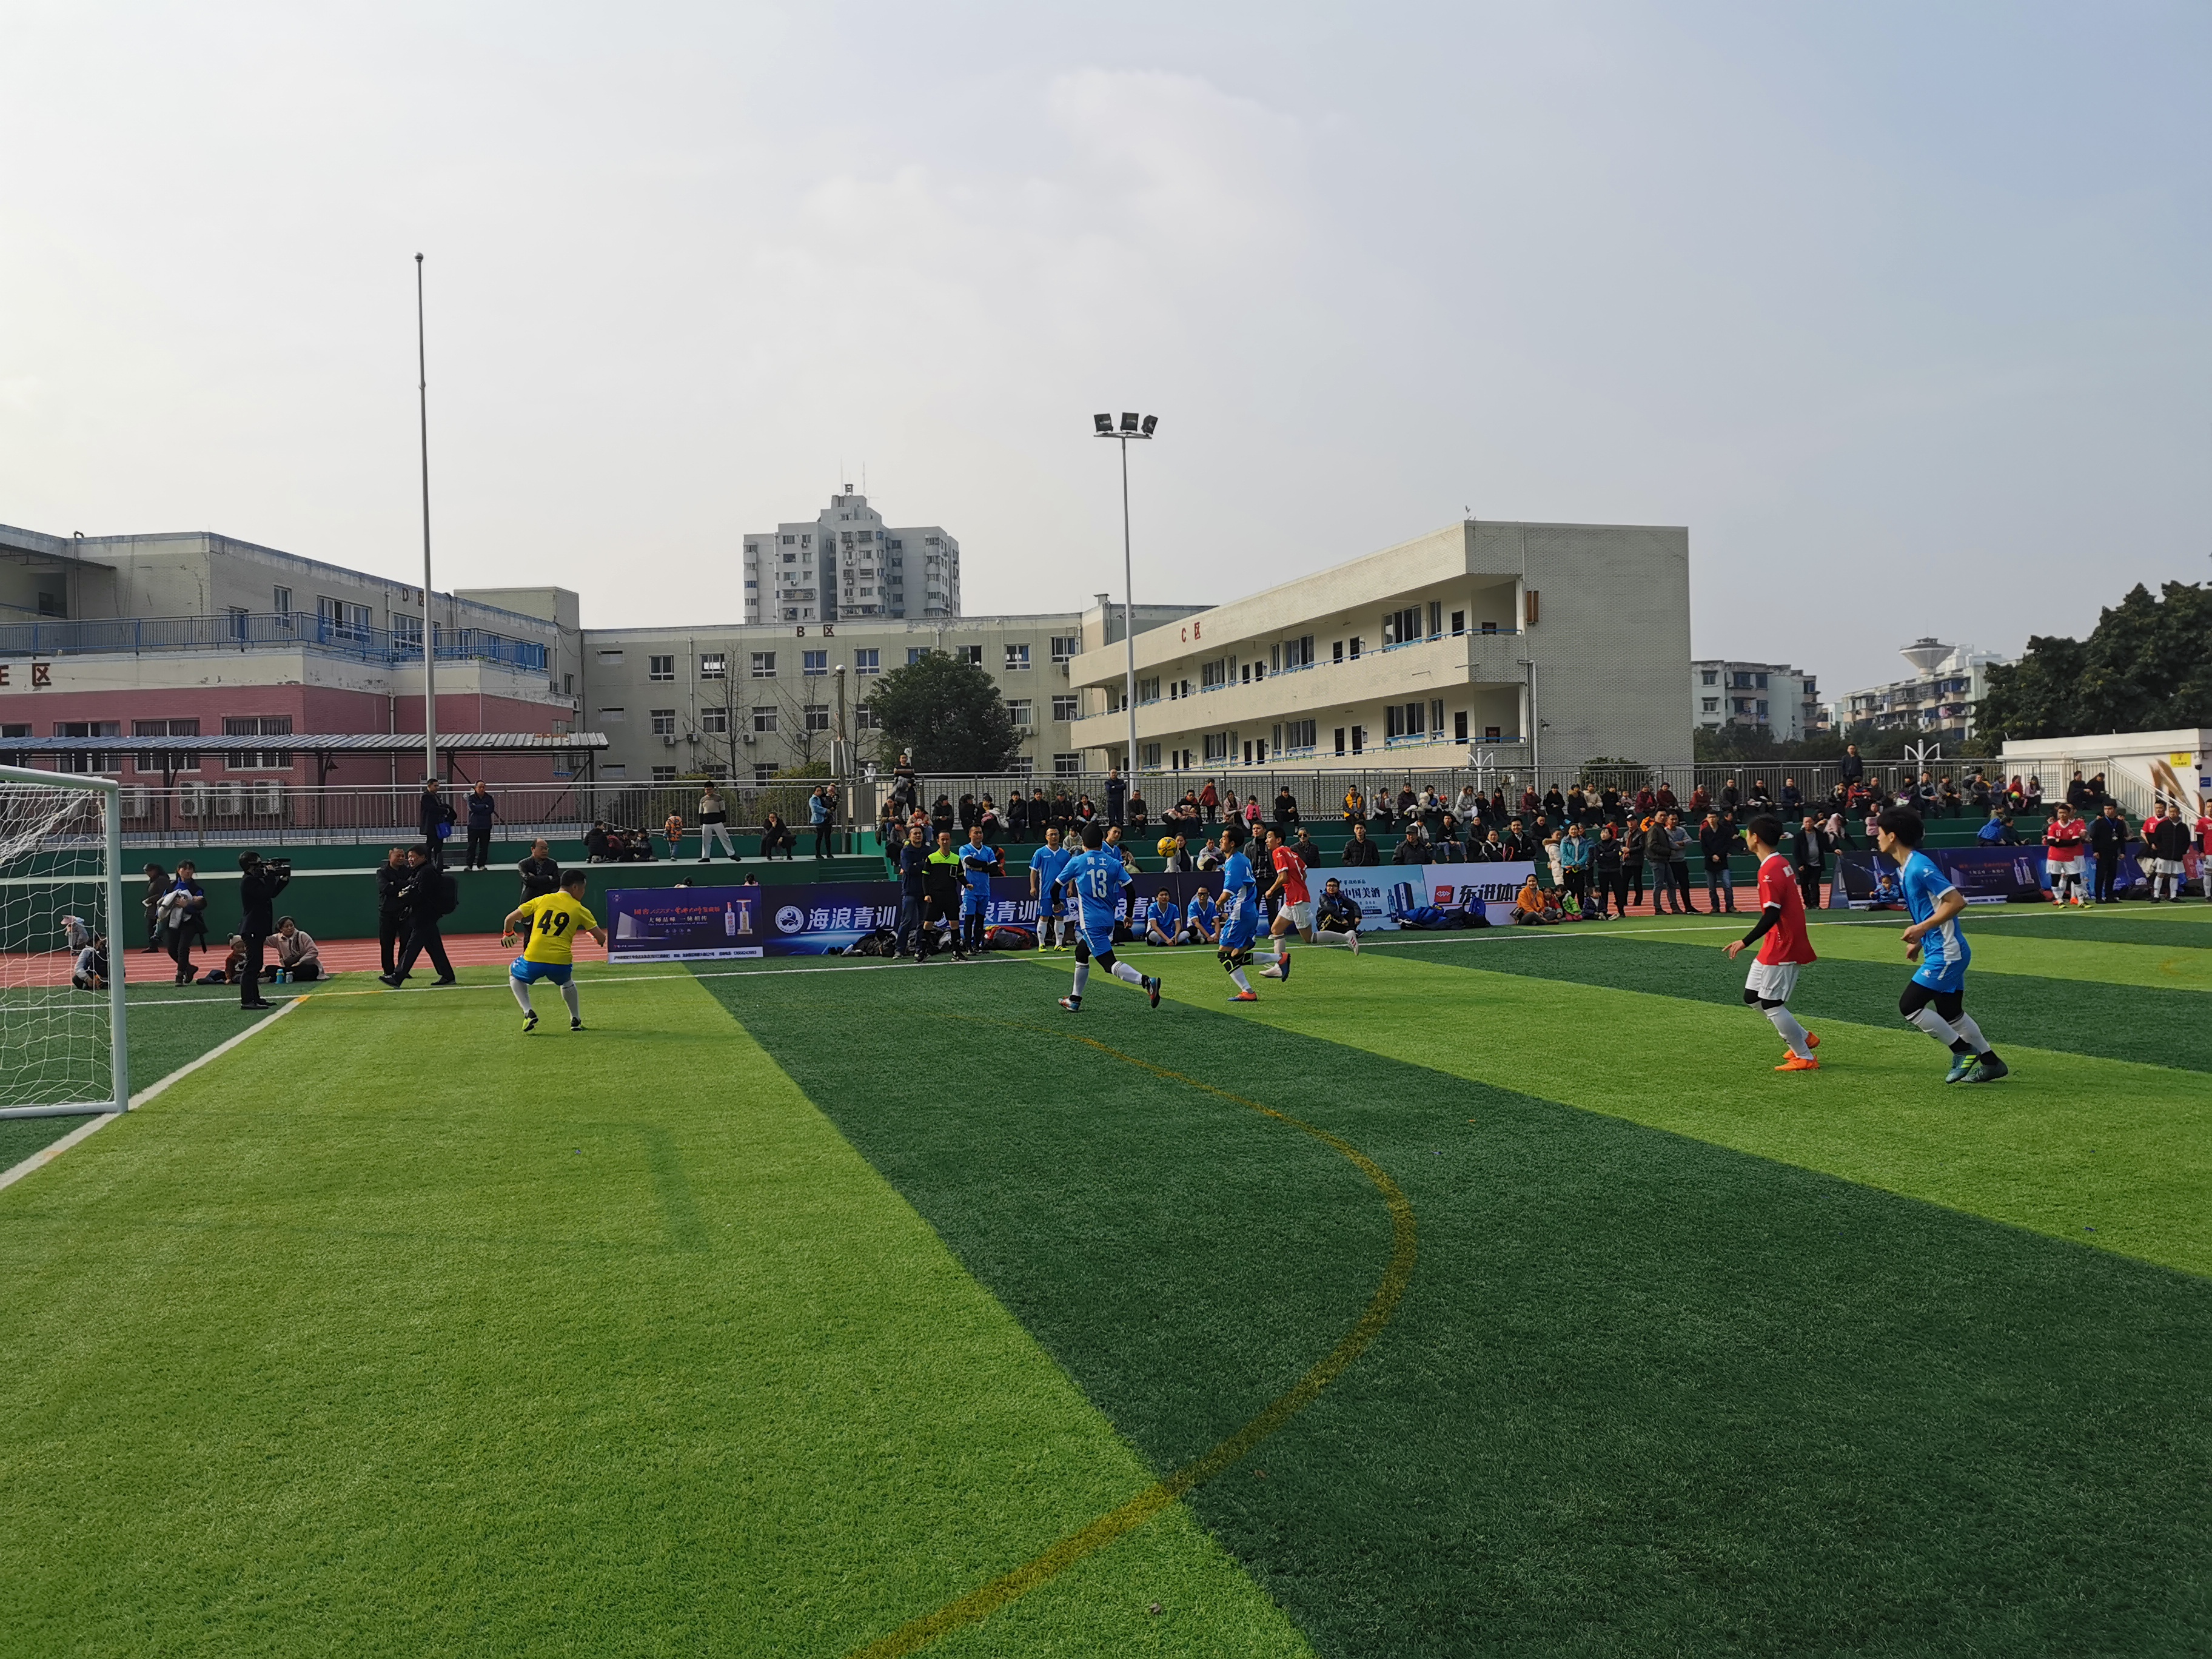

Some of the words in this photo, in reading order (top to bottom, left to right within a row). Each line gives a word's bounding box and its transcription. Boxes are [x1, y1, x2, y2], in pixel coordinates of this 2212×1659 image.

[1086, 868, 1108, 899] 13
[537, 910, 570, 937] 49
[806, 905, 897, 930] 海浪青训
